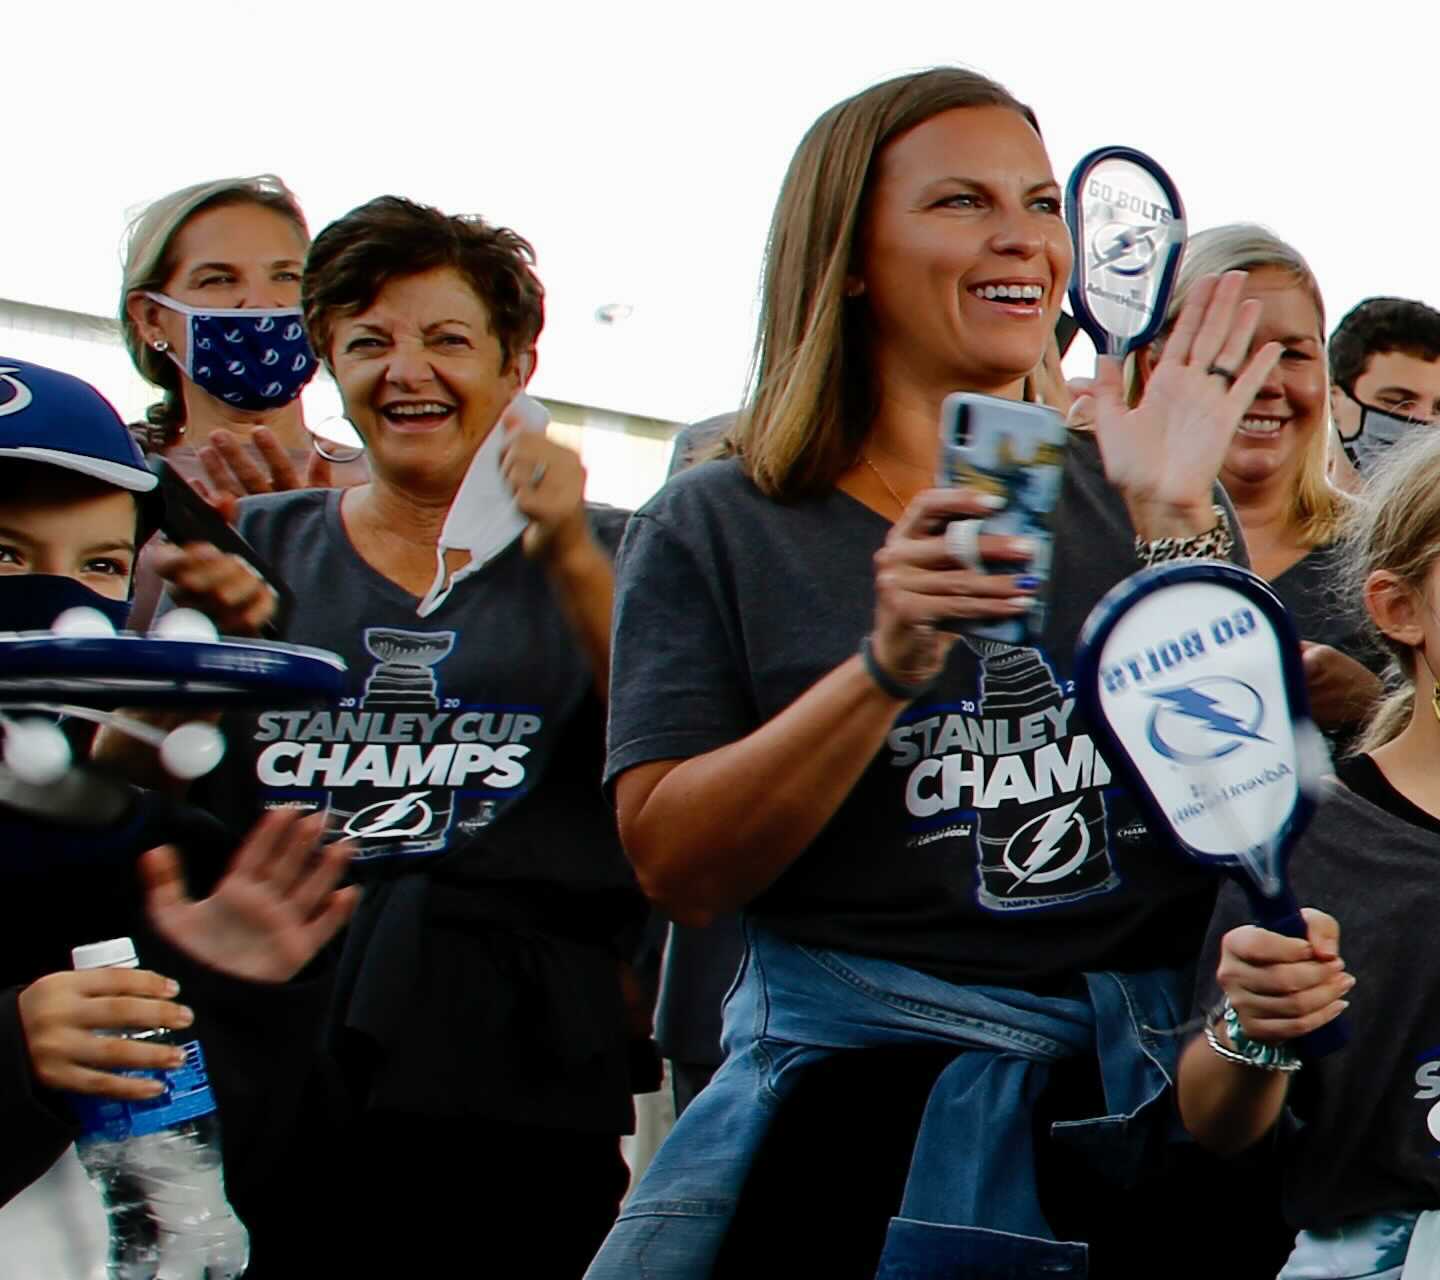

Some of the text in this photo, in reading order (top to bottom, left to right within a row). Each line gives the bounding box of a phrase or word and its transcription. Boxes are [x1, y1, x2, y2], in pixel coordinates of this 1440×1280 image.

[1088, 179, 1173, 225] GO BOLTS
[339, 698, 461, 709] 20 20
[961, 700, 975, 712] 20
[253, 710, 543, 743] STANLEY CUP
[888, 699, 1076, 768] STANLEY
[256, 741, 532, 789] CHAMPS
